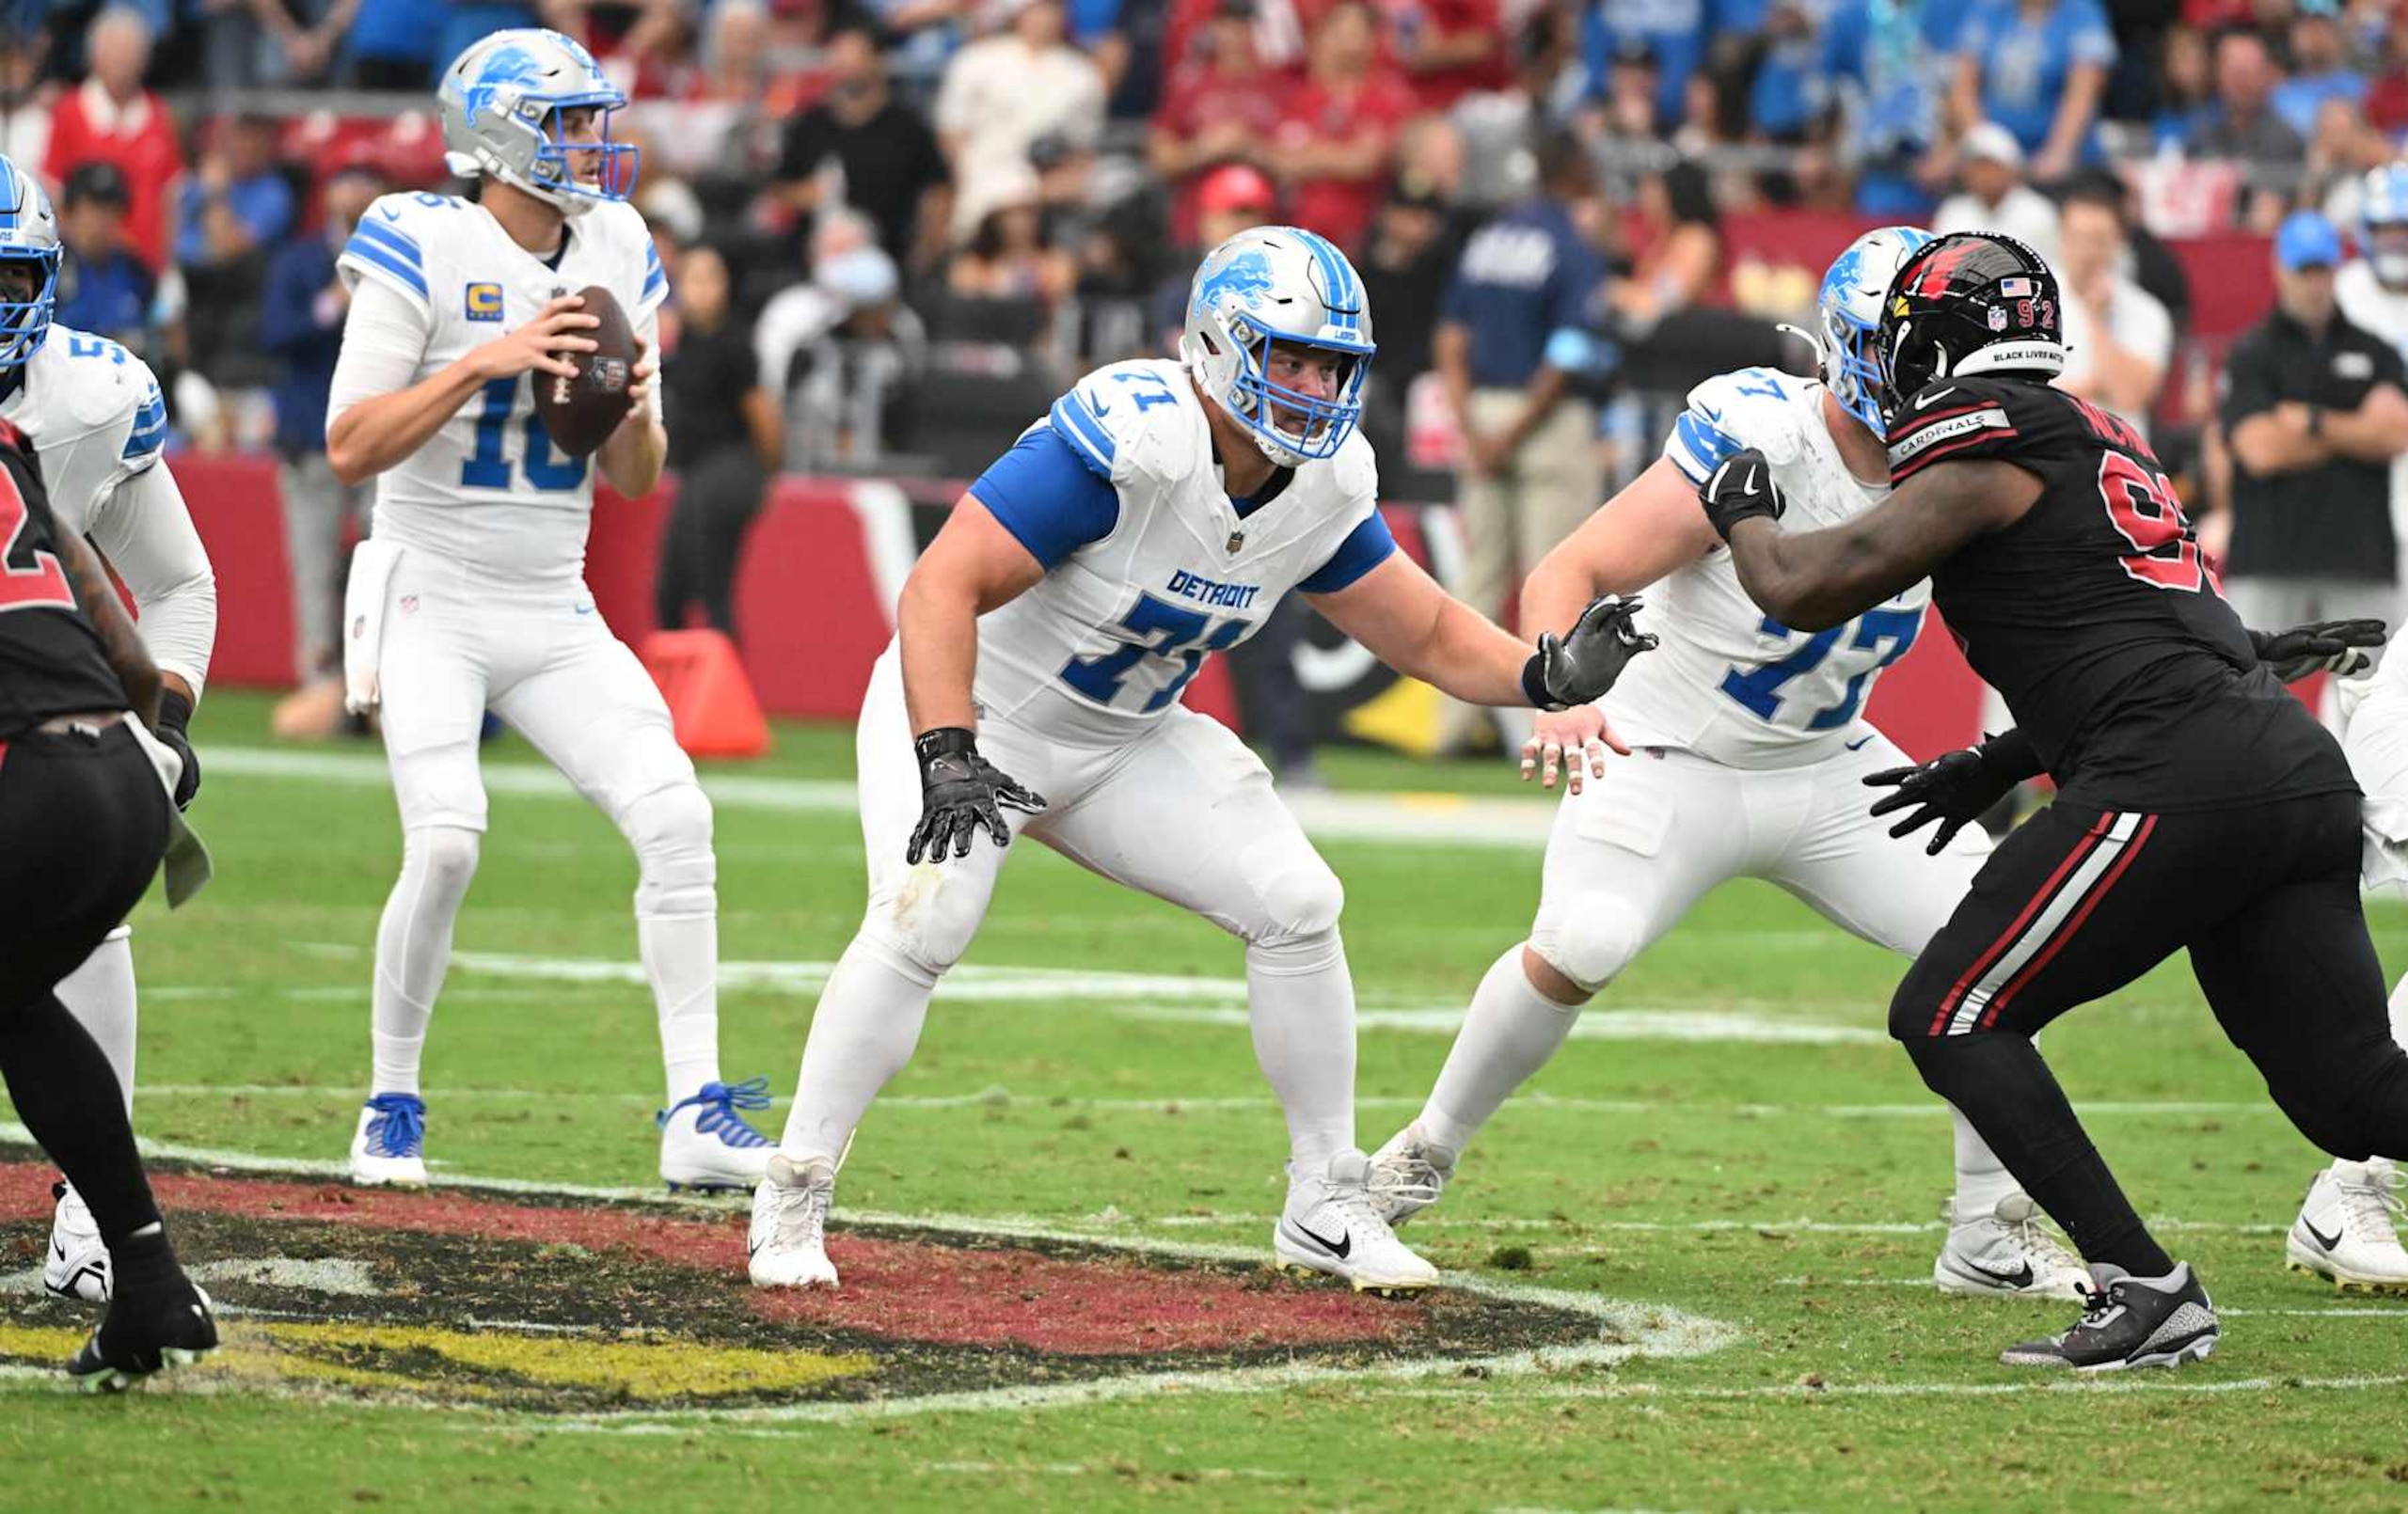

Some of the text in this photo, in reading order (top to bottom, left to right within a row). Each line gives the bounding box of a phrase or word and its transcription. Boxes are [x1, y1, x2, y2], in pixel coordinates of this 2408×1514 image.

[469, 285, 502, 312] C
[2018, 299, 2054, 329] 92
[1993, 351, 2023, 362] BLACK
[2025, 349, 2048, 359] LIVES
[1900, 415, 1986, 455] CARDINALS
[1166, 569, 1261, 609] DETROIT
[1058, 589, 1254, 713] 71
[1716, 600, 1926, 732] 77
